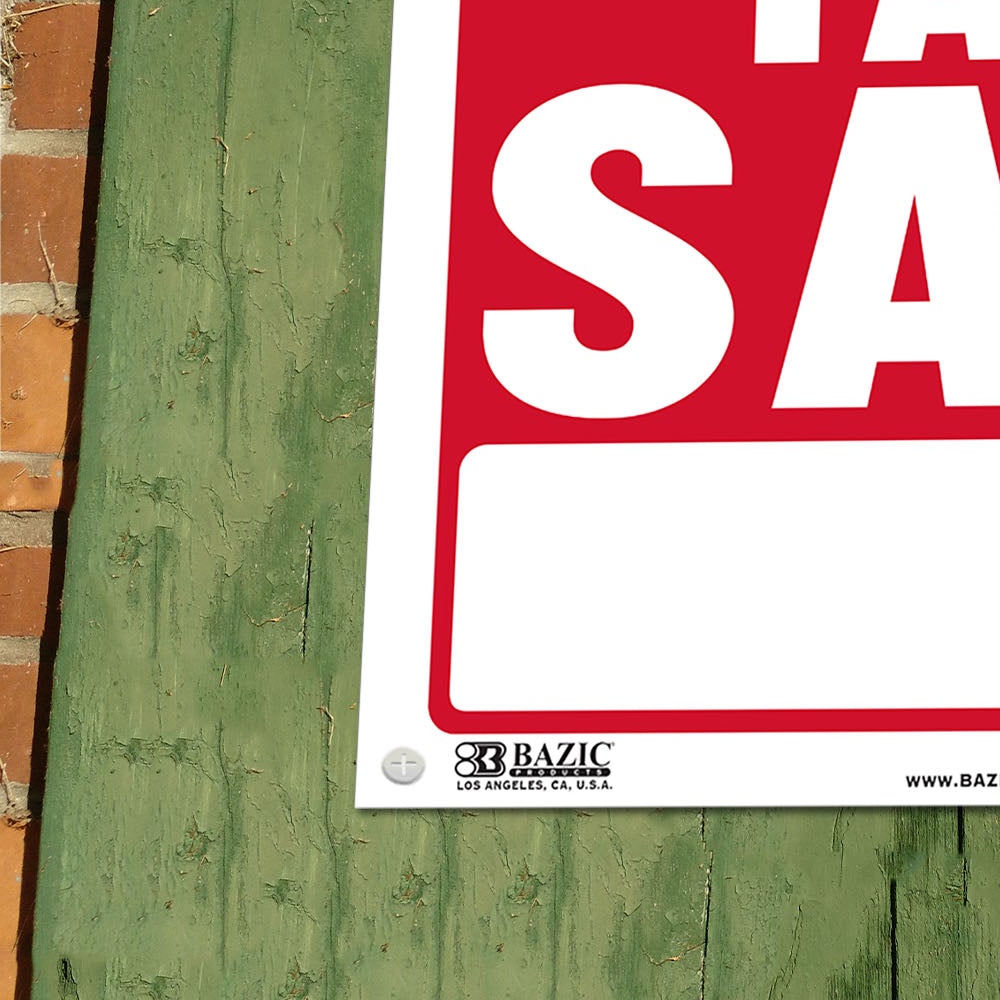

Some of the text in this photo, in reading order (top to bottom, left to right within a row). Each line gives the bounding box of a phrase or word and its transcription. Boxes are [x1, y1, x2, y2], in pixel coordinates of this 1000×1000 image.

[513, 741, 612, 768] BAZIC
[514, 768, 603, 777] PRODUCTS
[457, 780, 613, 791] LOS ANGELES, CA, U.S.A.
